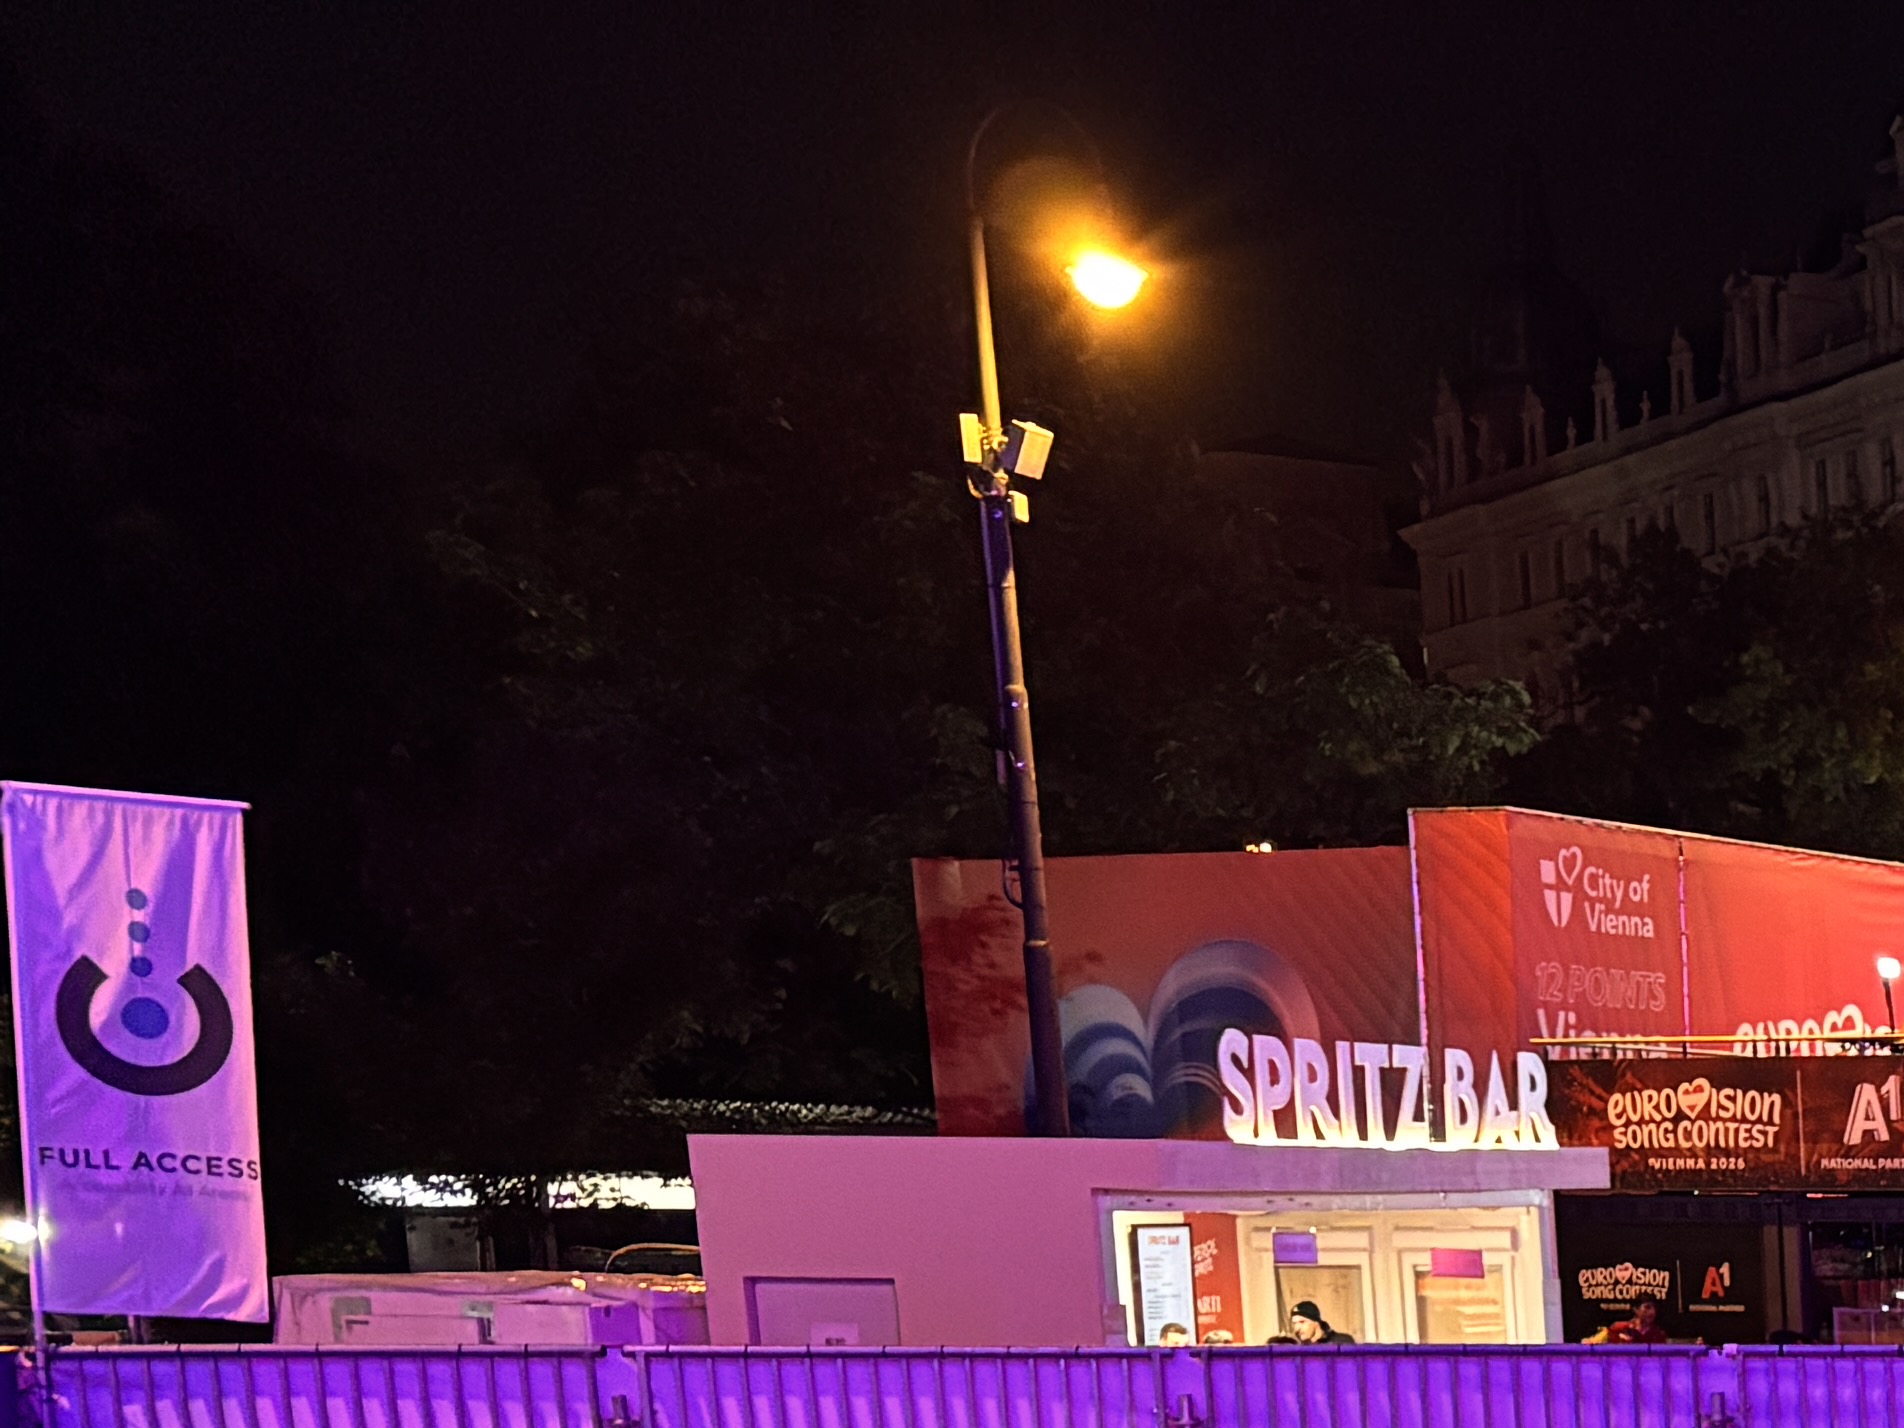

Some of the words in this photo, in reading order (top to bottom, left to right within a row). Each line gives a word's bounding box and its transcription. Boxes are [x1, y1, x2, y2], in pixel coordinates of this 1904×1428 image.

[1583, 866, 1624, 909] City
[1629, 874, 1651, 903] of
[1584, 901, 1655, 939] Vienna
[1535, 962, 1564, 1001] 12
[1569, 964, 1666, 1012] POINTS
[1218, 1027, 1435, 1150] SPRITZ
[1443, 1047, 1561, 1151] BAR
[1843, 1073, 1903, 1146] A1
[1613, 1123, 1676, 1150] SONG
[1677, 1120, 1780, 1149] CONTEST
[1648, 1156, 1706, 1170] VIENNA
[1710, 1156, 1746, 1171] 2026
[1820, 1157, 1877, 1170] NATIONAL
[1701, 1261, 1731, 1299] A1
